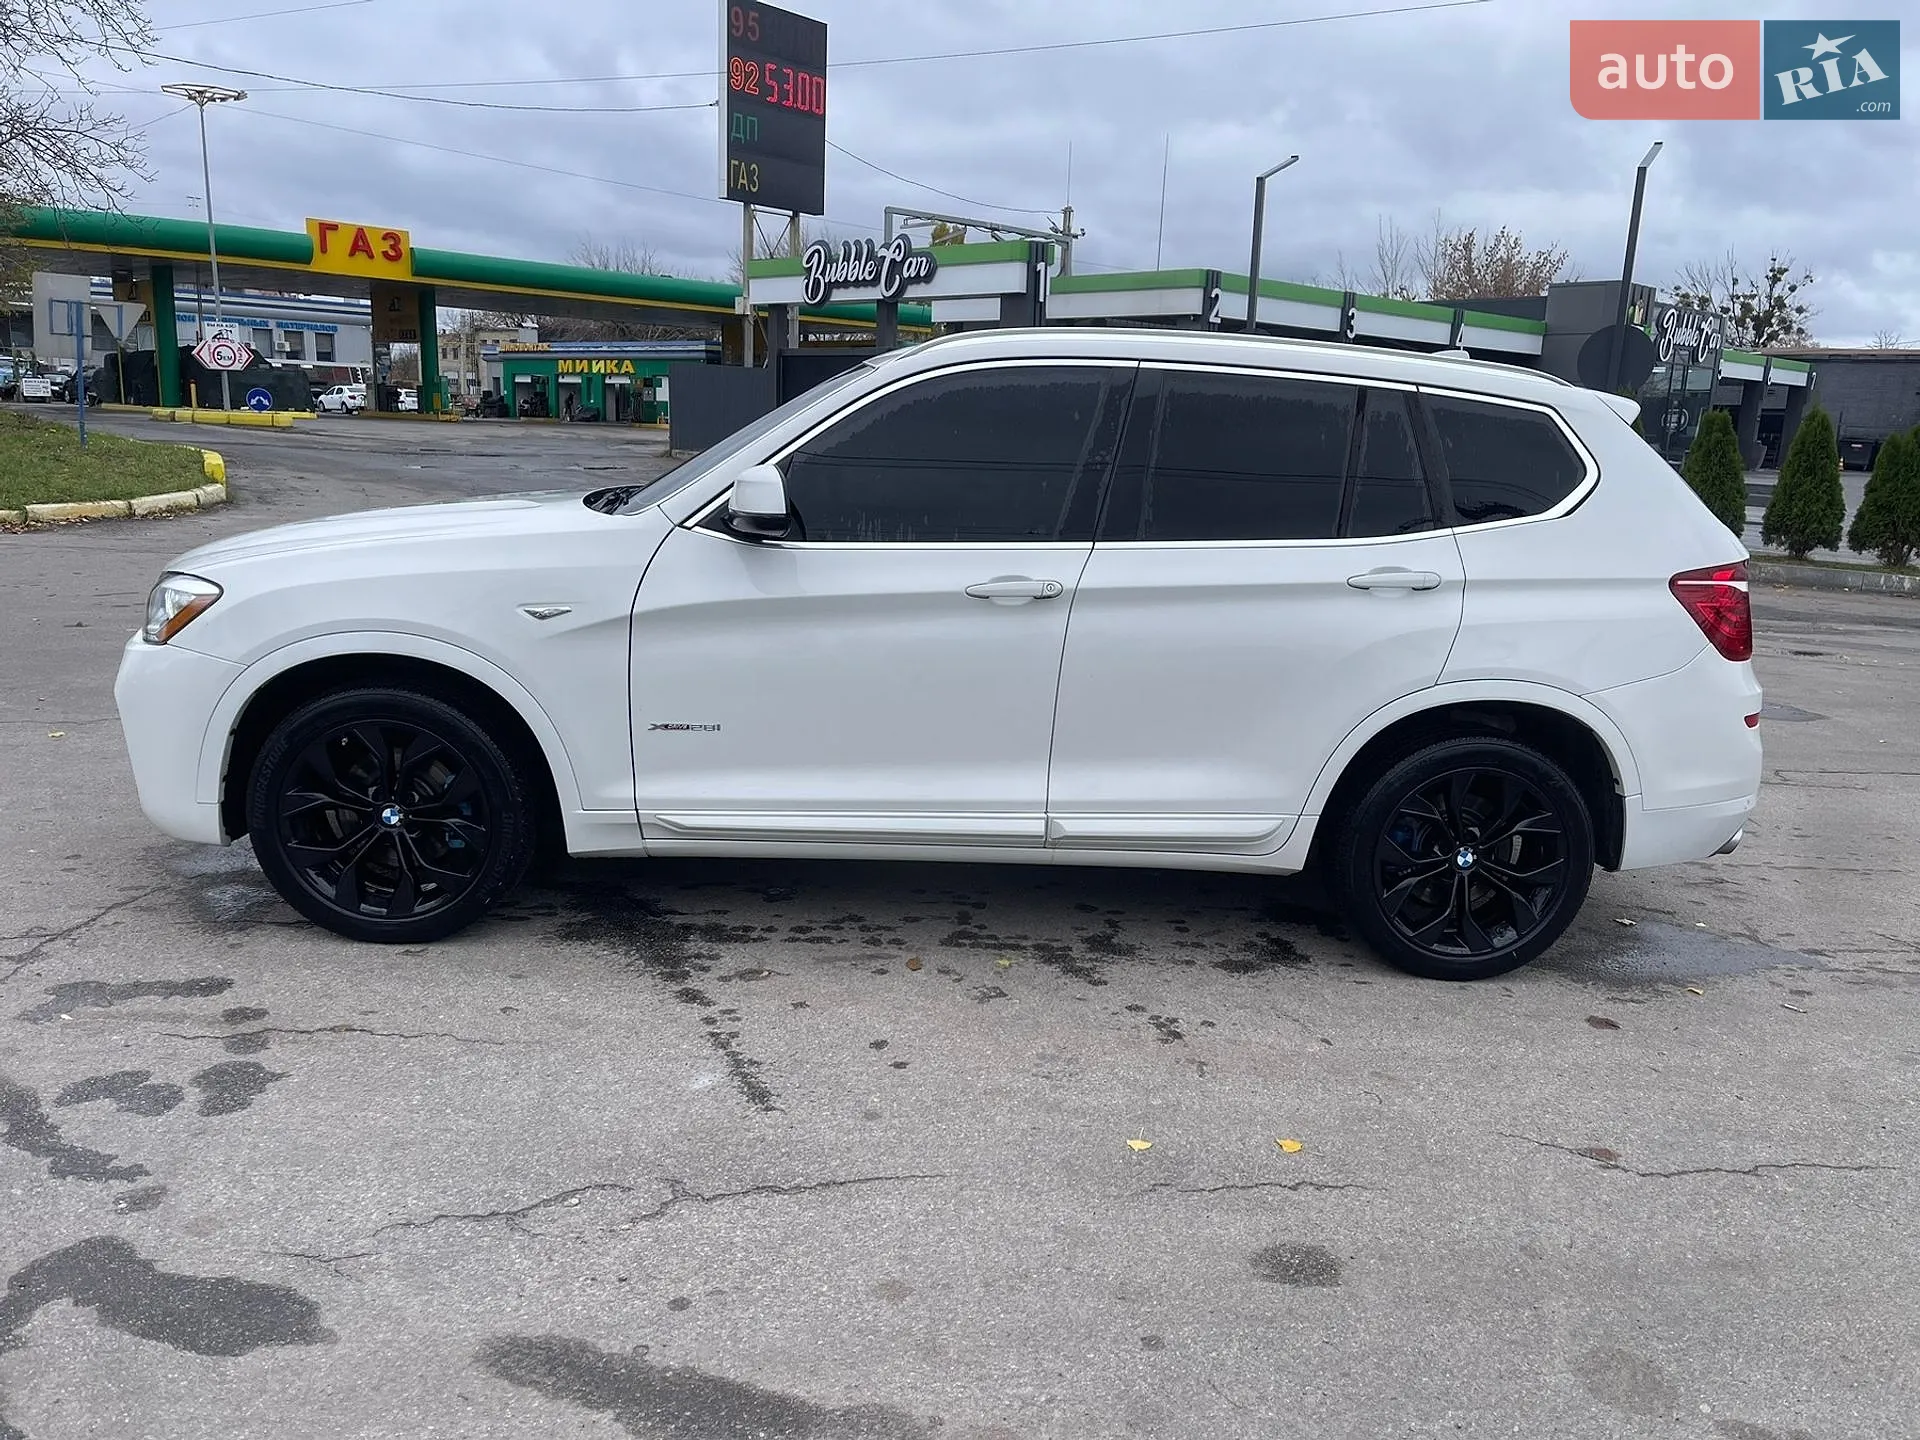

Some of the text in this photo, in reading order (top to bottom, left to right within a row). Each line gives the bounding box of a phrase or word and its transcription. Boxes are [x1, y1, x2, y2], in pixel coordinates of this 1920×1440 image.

[730, 5, 761, 42] 95
[729, 55, 825, 116] 92 53.00
[730, 112, 760, 143] ДП
[729, 158, 760, 194] ГАЗ
[317, 221, 404, 263] ГАЗ
[802, 238, 932, 306] Bubble Car
[1035, 261, 1047, 304] 1
[1209, 288, 1222, 325] 2
[1346, 307, 1358, 339] 3
[1455, 323, 1465, 351] 4
[1659, 308, 1700, 362] Bubble
